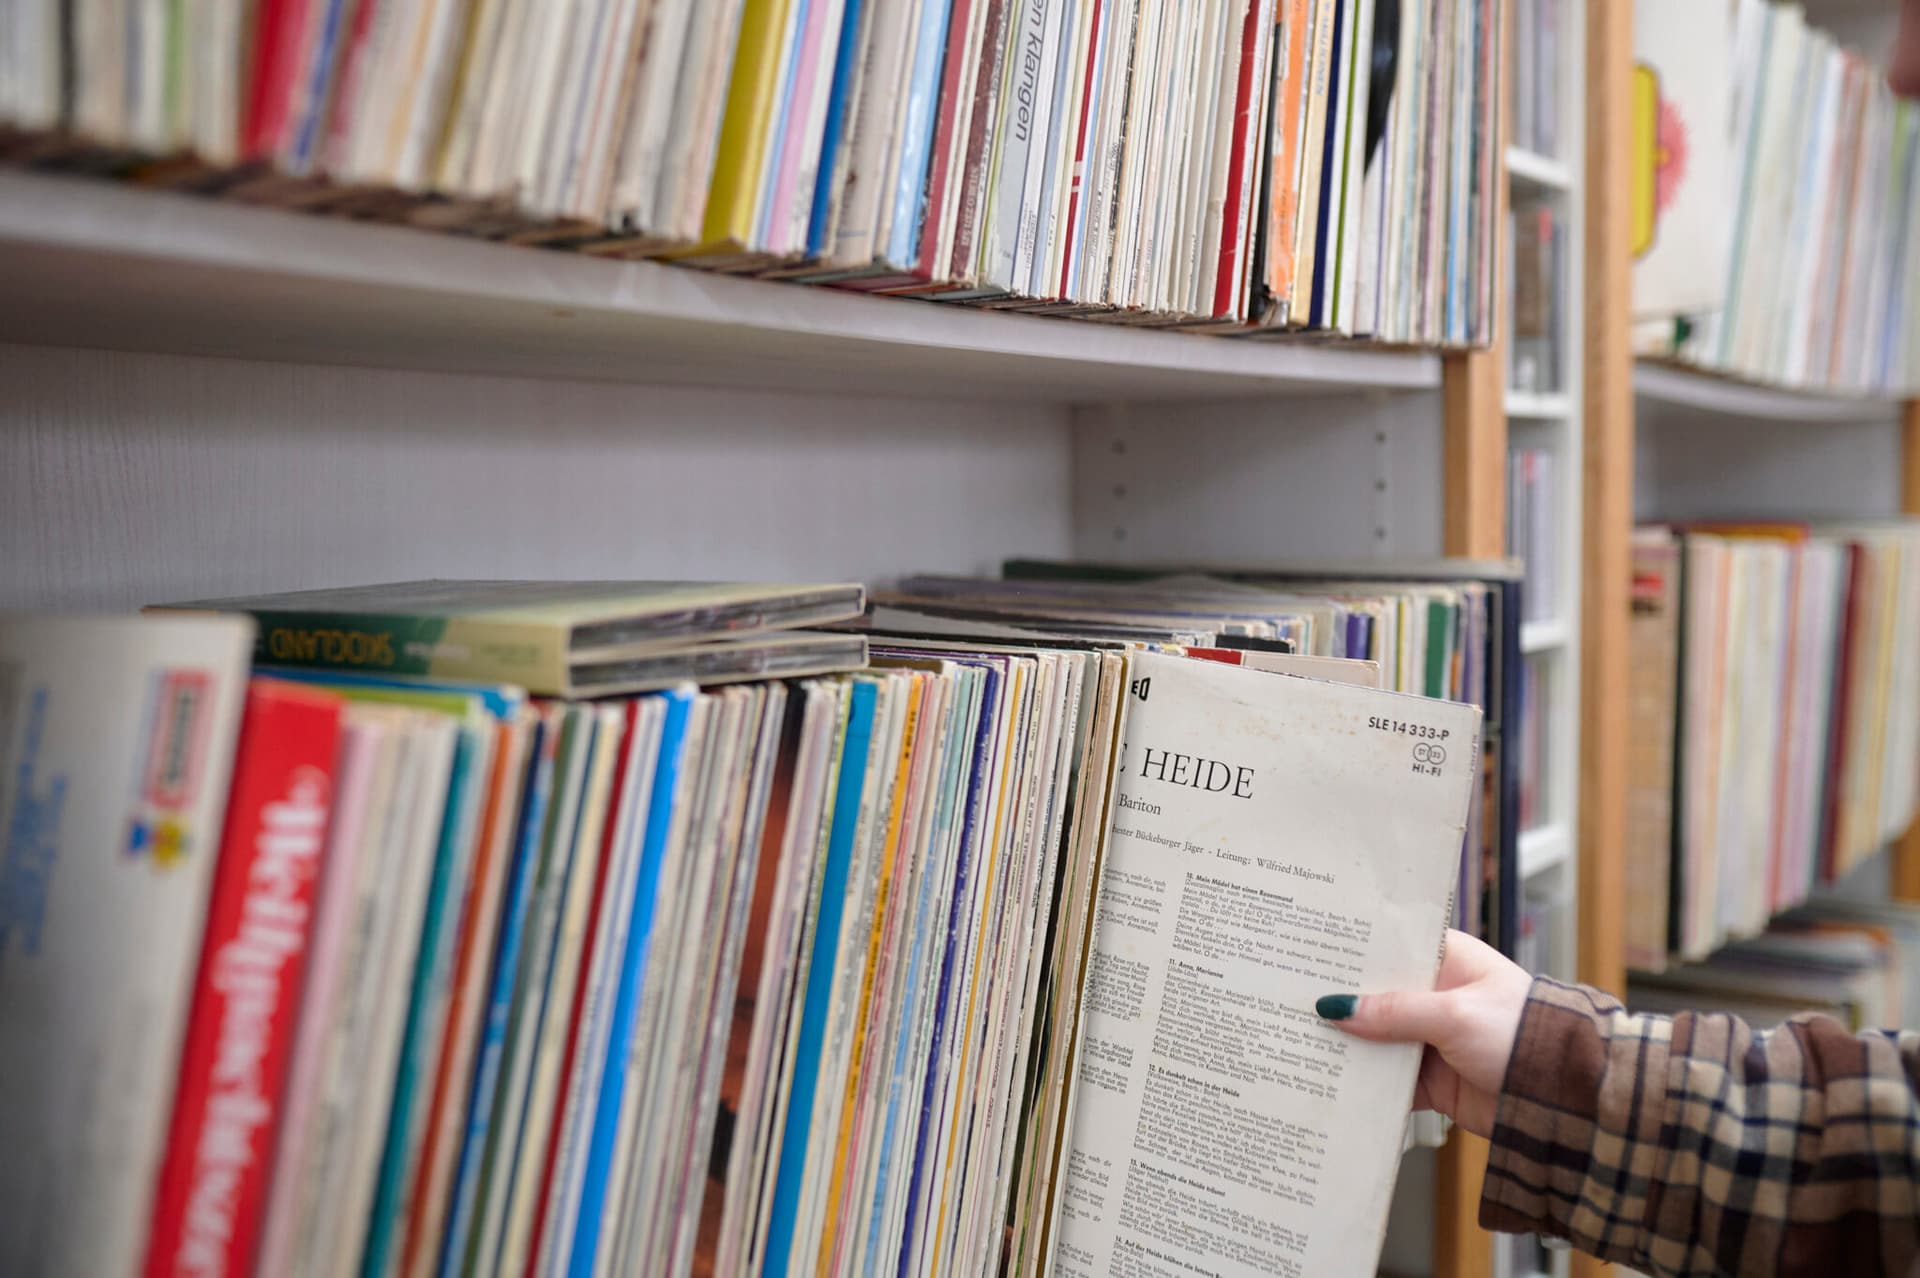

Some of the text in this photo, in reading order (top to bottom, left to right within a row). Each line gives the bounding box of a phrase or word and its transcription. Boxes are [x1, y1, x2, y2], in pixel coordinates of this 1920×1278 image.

[1368, 716, 1389, 732] SLE
[1139, 747, 1255, 799] HEIDE
[1412, 763, 1442, 777] HI-FI
[1119, 793, 1161, 816] Bariton
[1183, 839, 1204, 855] Jäger
[1216, 848, 1251, 866] Leitung:
[1257, 856, 1292, 875] Wilfried
[1294, 864, 1335, 885] Majowski
